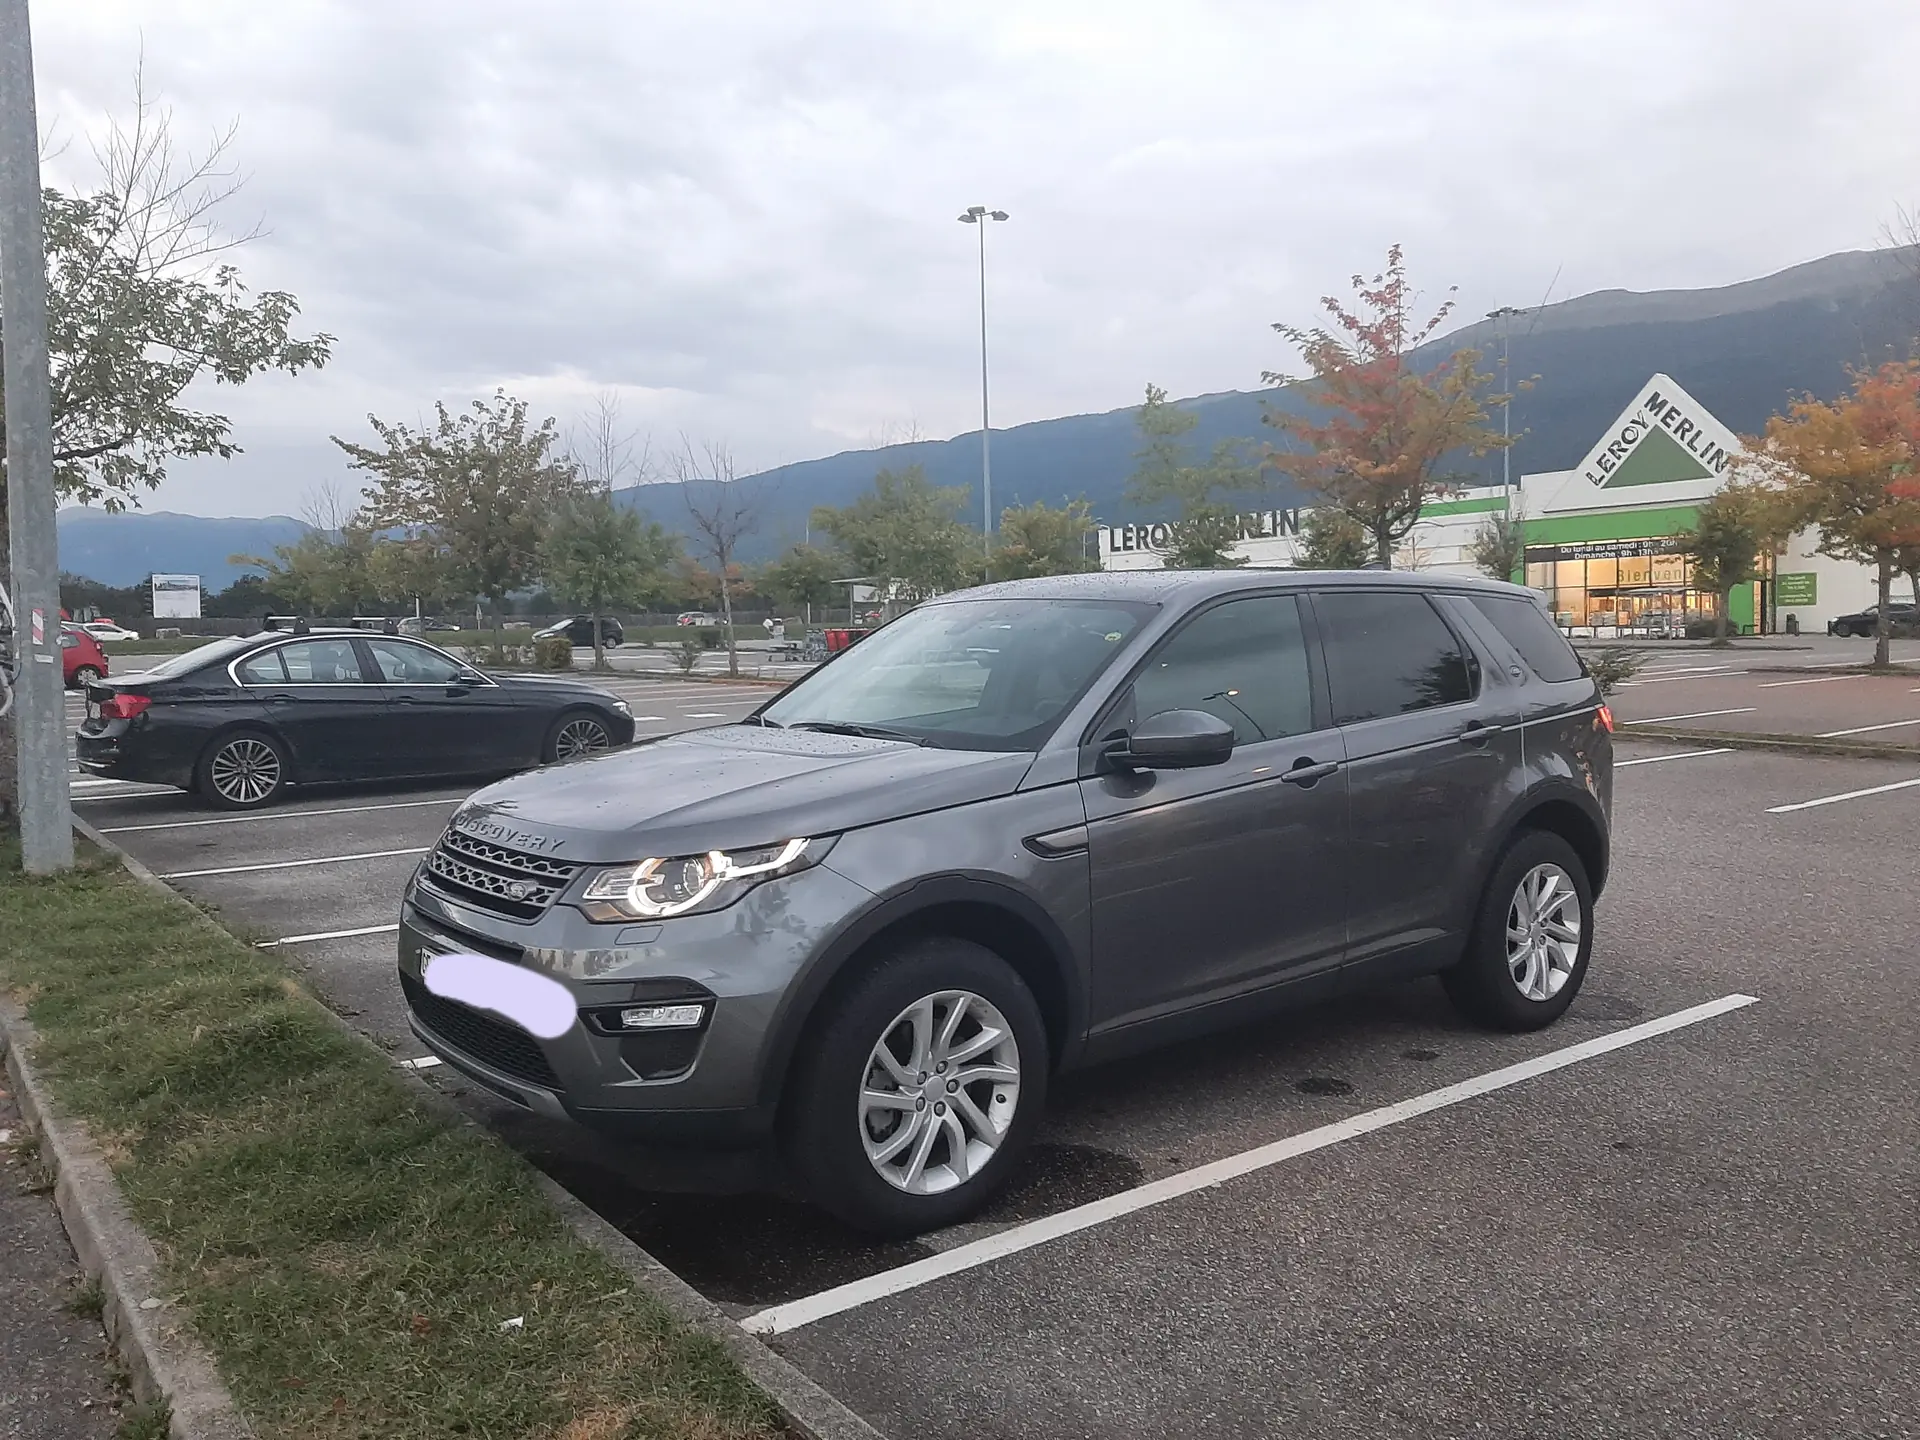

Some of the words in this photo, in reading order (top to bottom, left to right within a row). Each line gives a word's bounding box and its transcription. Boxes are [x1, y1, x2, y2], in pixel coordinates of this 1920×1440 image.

[1585, 410, 1649, 486] LEROY
[1644, 390, 1728, 474] MERLIN
[1573, 544, 1593, 552] lundi
[1606, 542, 1637, 550] samedi
[1574, 550, 1615, 559] Dimanche
[455, 811, 565, 852] DISCOVERY
